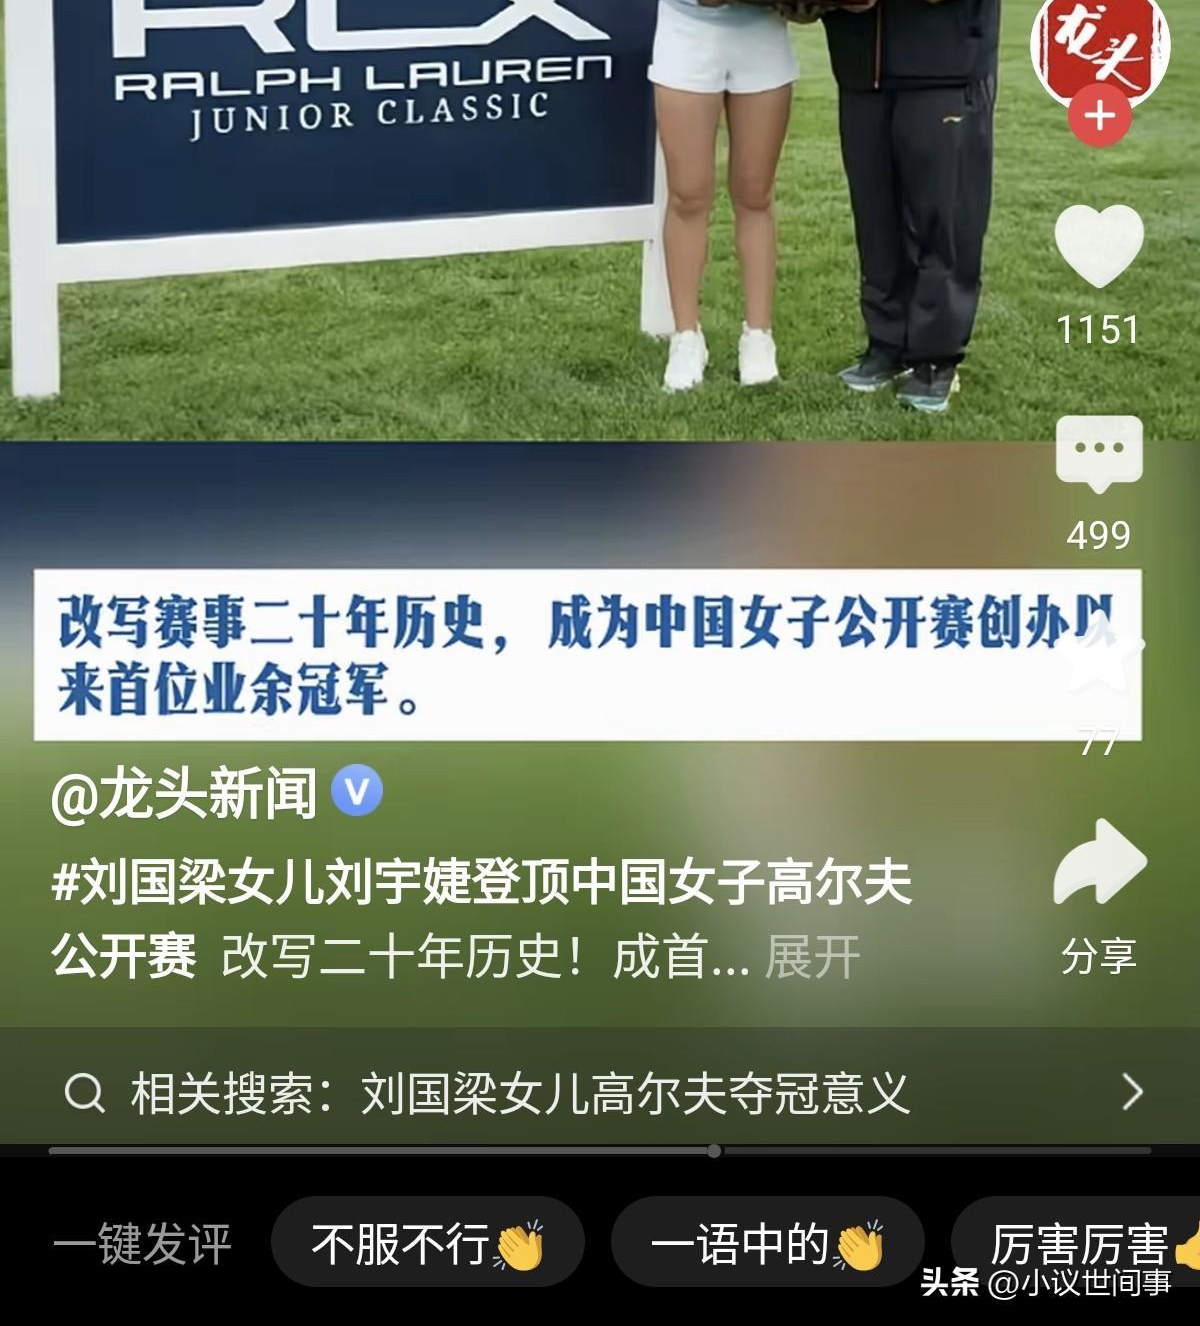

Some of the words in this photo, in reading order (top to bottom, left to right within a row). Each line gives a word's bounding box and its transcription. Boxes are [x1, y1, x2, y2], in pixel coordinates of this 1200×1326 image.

[115, 67, 341, 101] RALPH
[366, 55, 613, 90] LAUREN
[190, 102, 354, 143] JUNIOR
[377, 92, 549, 125] CLASSIC
